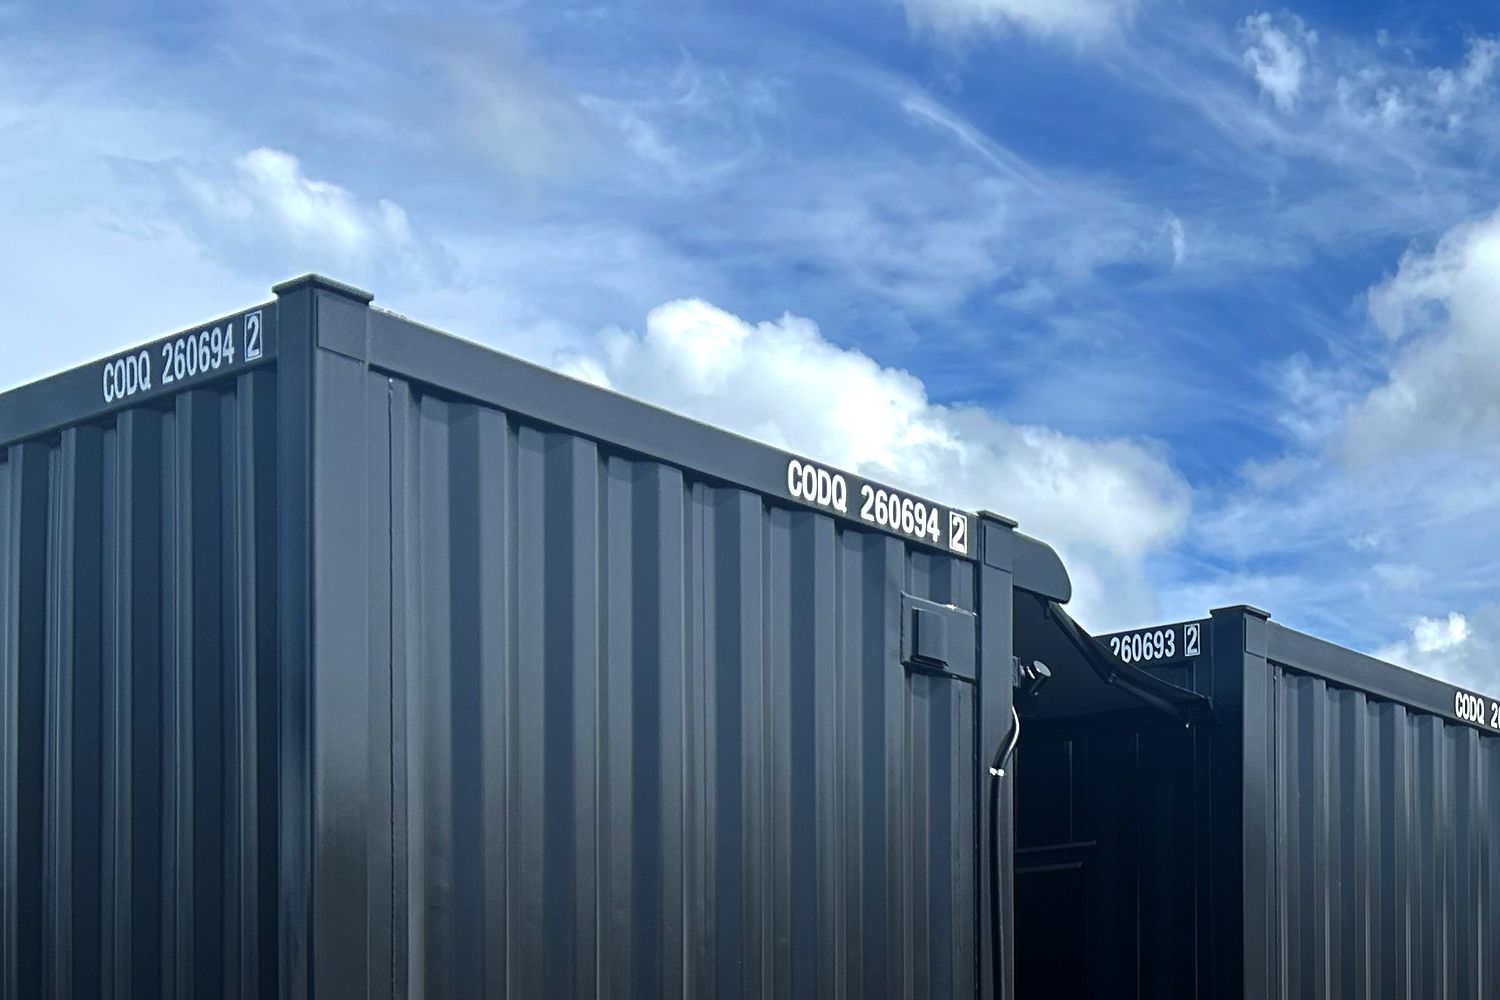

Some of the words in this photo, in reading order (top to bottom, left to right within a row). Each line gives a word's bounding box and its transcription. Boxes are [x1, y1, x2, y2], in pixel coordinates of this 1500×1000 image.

[103, 350, 151, 403] CODQ
[162, 323, 234, 385] 260694
[246, 313, 261, 360] 2
[788, 459, 847, 514] CODQ
[860, 484, 941, 543] 260694
[950, 514, 966, 552] 2
[1185, 625, 1199, 655] 2
[1455, 691, 1485, 726] CODQ
